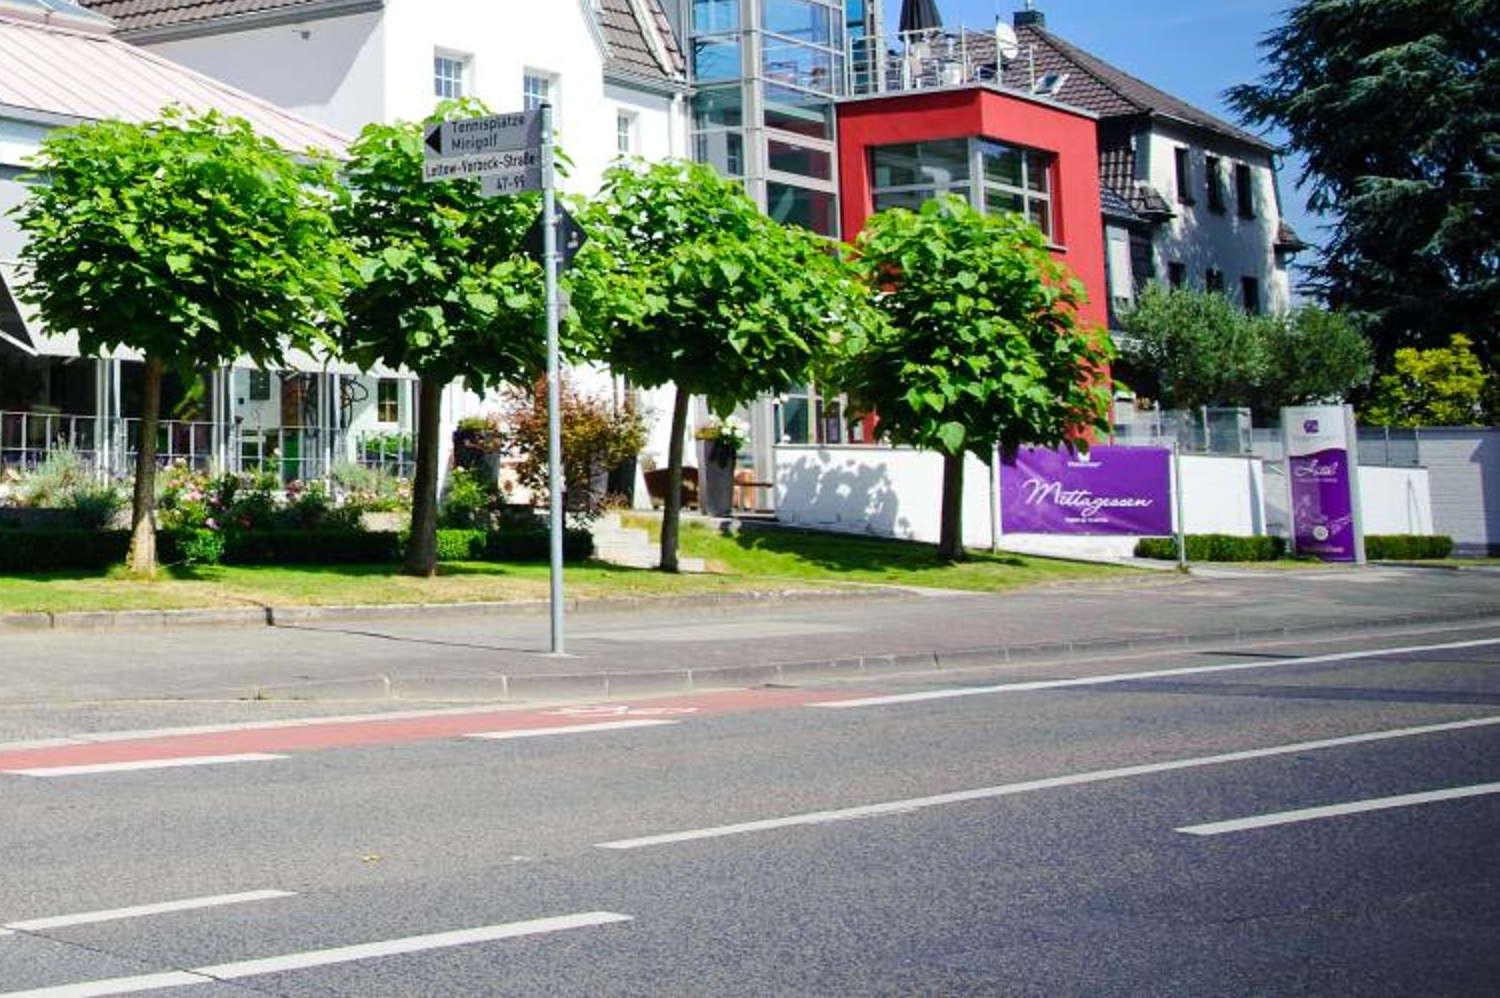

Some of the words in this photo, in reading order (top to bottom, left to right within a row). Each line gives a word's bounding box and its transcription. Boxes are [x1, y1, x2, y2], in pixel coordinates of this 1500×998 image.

[452, 115, 525, 133] Tennisplätze
[452, 134, 498, 151] Minigolf
[1022, 479, 1153, 517] Mittagessen
